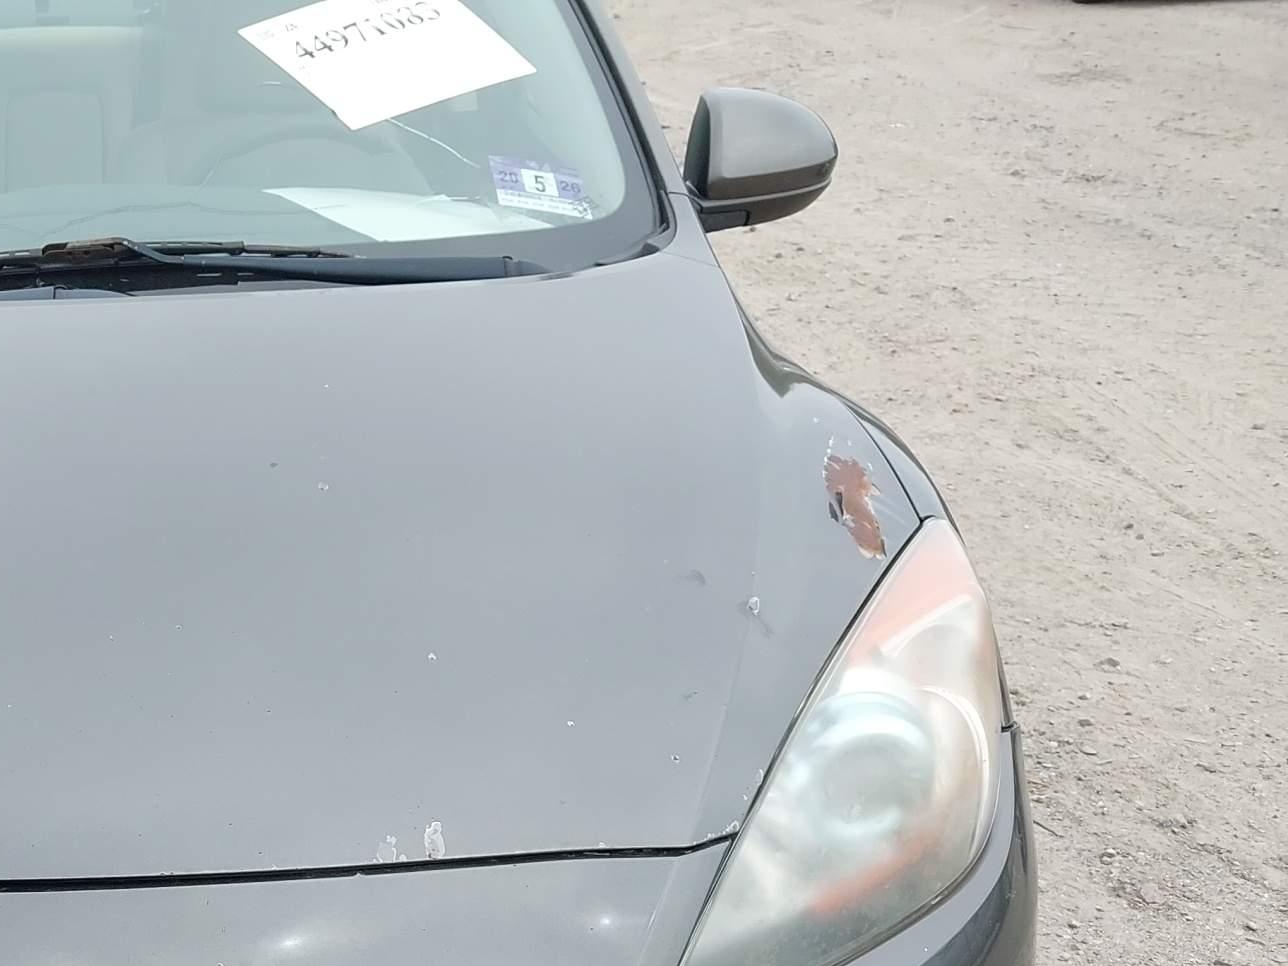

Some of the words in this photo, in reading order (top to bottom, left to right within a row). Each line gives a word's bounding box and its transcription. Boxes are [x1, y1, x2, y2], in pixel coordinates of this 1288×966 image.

[497, 170, 520, 184] 20
[534, 175, 546, 192] 5
[559, 180, 582, 194] 26
